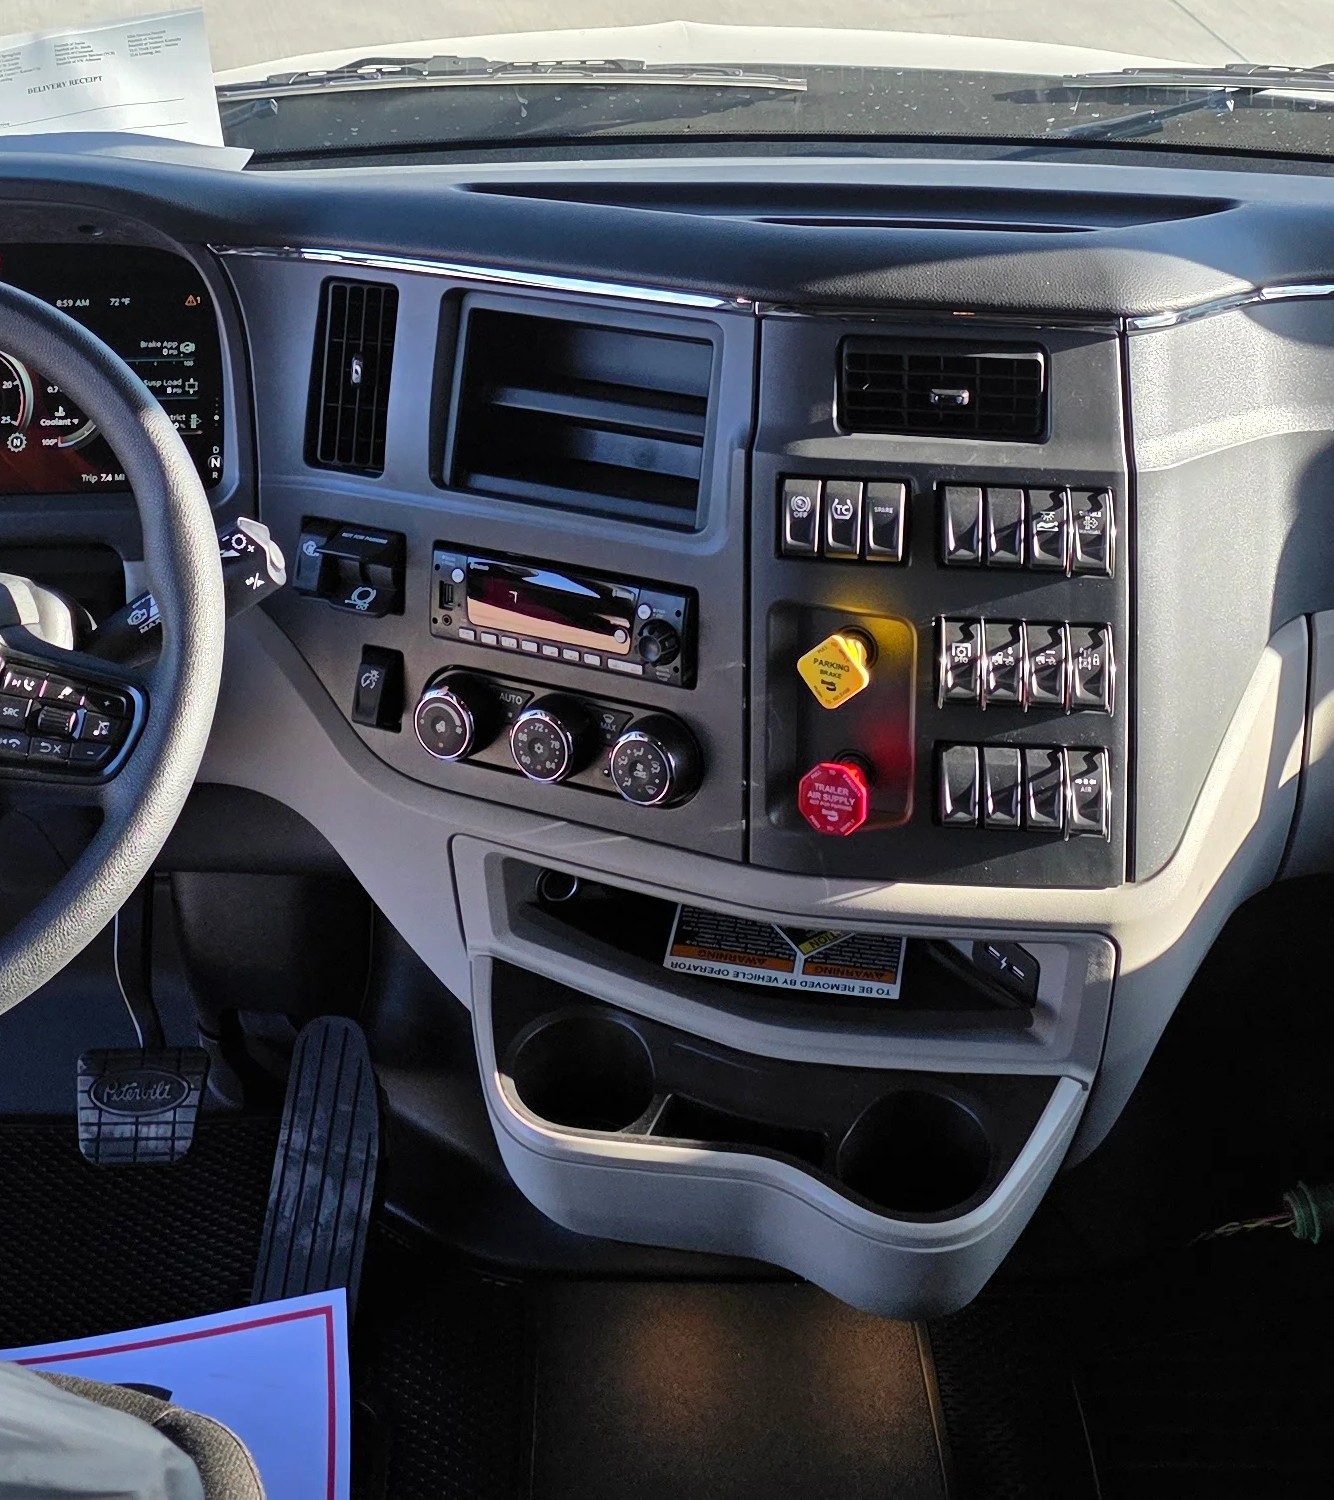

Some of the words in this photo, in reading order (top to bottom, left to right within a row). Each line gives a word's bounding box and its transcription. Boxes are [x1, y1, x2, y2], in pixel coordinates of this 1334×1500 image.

[27, 79, 67, 95] DELIVERY
[69, 75, 104, 89] RECEIPT
[56, 299, 73, 307] 8:59
[75, 299, 89, 307] AM
[110, 298, 120, 306] 72
[163, 341, 178, 350] App
[144, 379, 162, 387] Susp
[164, 378, 182, 386] Load
[40, 418, 71, 426] Coolant
[13, 438, 20, 446] N
[212, 458, 221, 468] N
[82, 474, 97, 483] Trip
[836, 505, 849, 514] TC
[813, 658, 850, 672] PARKING
[820, 669, 842, 679] BRAKE
[499, 693, 522, 705] AUTO
[3, 707, 19, 717] SRC
[534, 723, 544, 732] 72
[600, 722, 617, 732] MAX
[815, 783, 849, 796] TRAILER
[807, 791, 821, 800] AIR
[823, 794, 855, 806] SUPPLY
[698, 950, 758, 964] WARNING
[670, 961, 730, 978] OPERATOR
[815, 965, 875, 979] WARNING
[733, 971, 779, 984] VEHICLE
[781, 978, 796, 986] BY
[800, 978, 855, 992] REMOVED
[858, 985, 873, 994] BE
[876, 987, 892, 996] TO
[103, 1081, 172, 1104] Peterbilt
